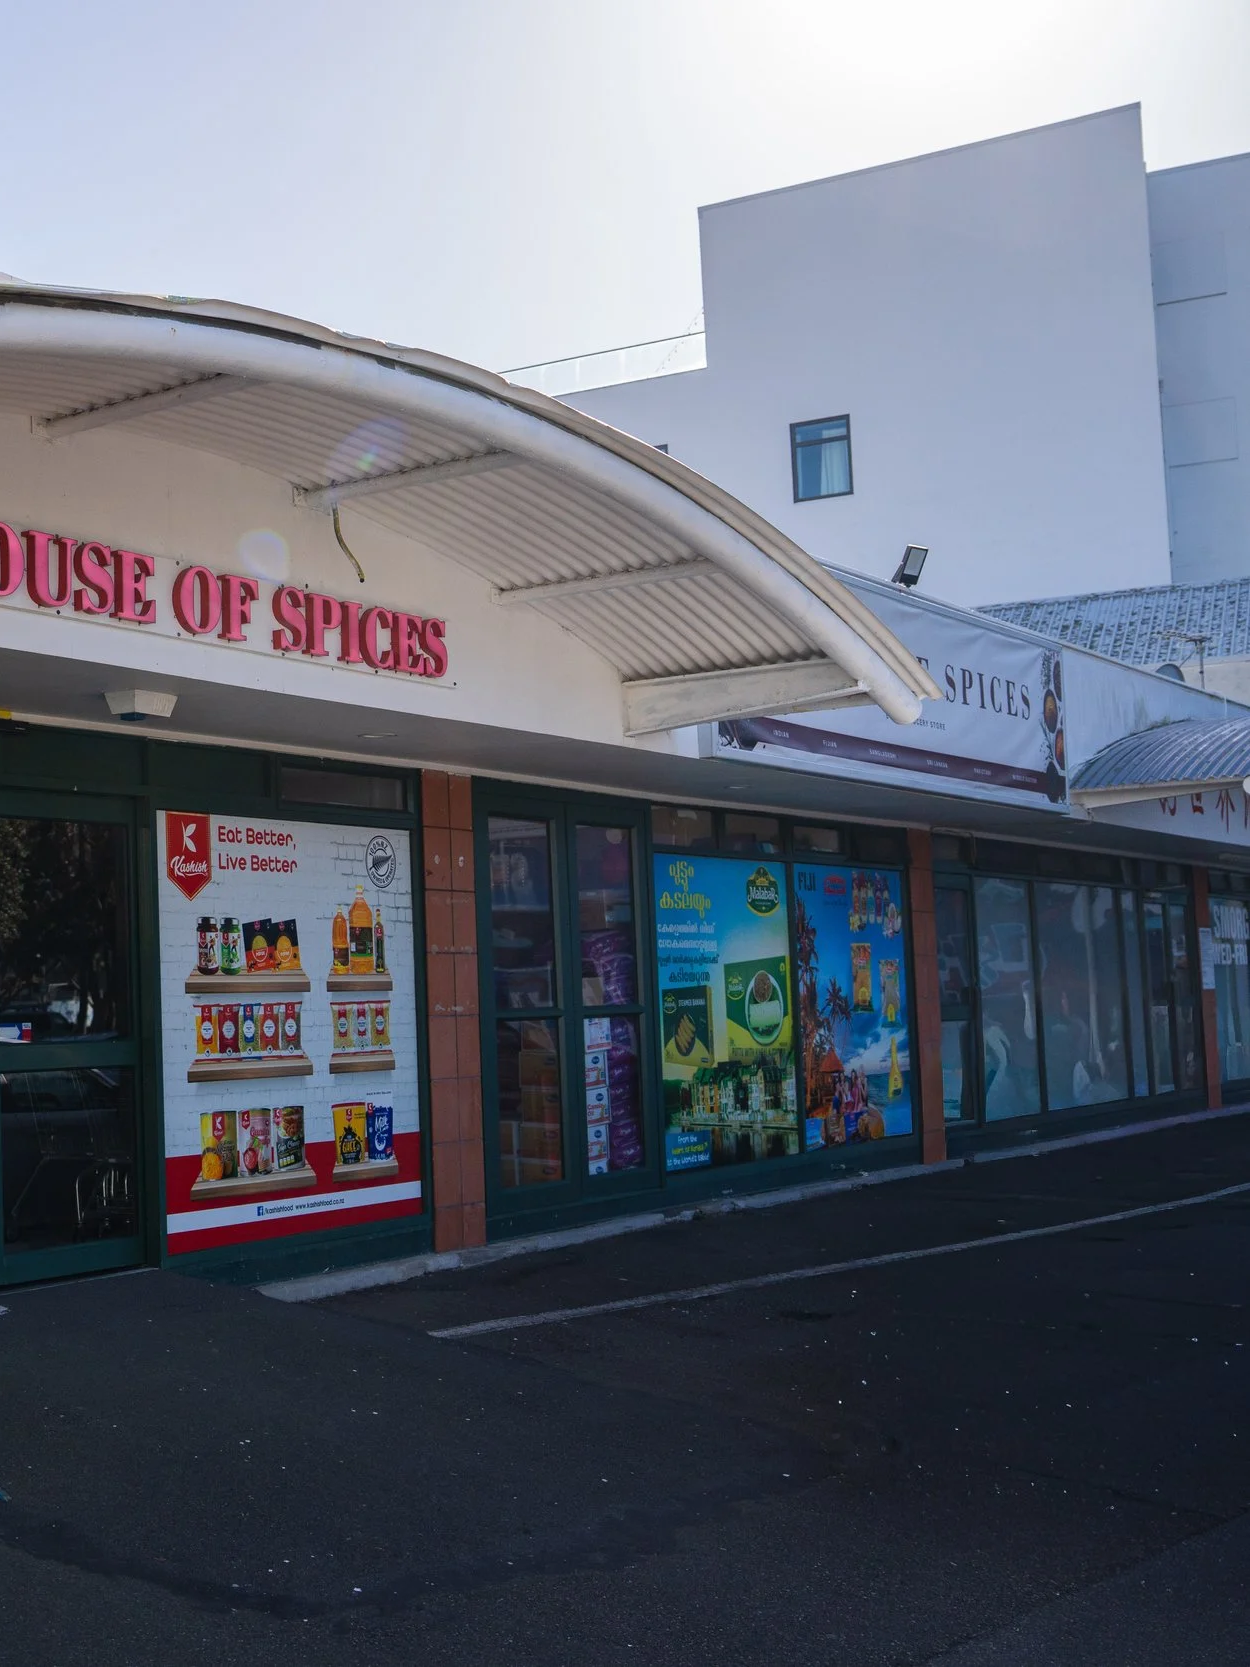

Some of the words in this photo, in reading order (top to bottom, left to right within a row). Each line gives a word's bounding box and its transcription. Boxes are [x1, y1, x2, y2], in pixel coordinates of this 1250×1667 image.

[171, 564, 259, 642] OF
[271, 585, 449, 678] SPICES
[944, 664, 1031, 721] SPICES
[218, 826, 242, 844] Eat
[246, 828, 296, 851] Better,
[170, 855, 207, 879] Kashish
[218, 853, 247, 871] Live
[251, 855, 297, 873] Better
